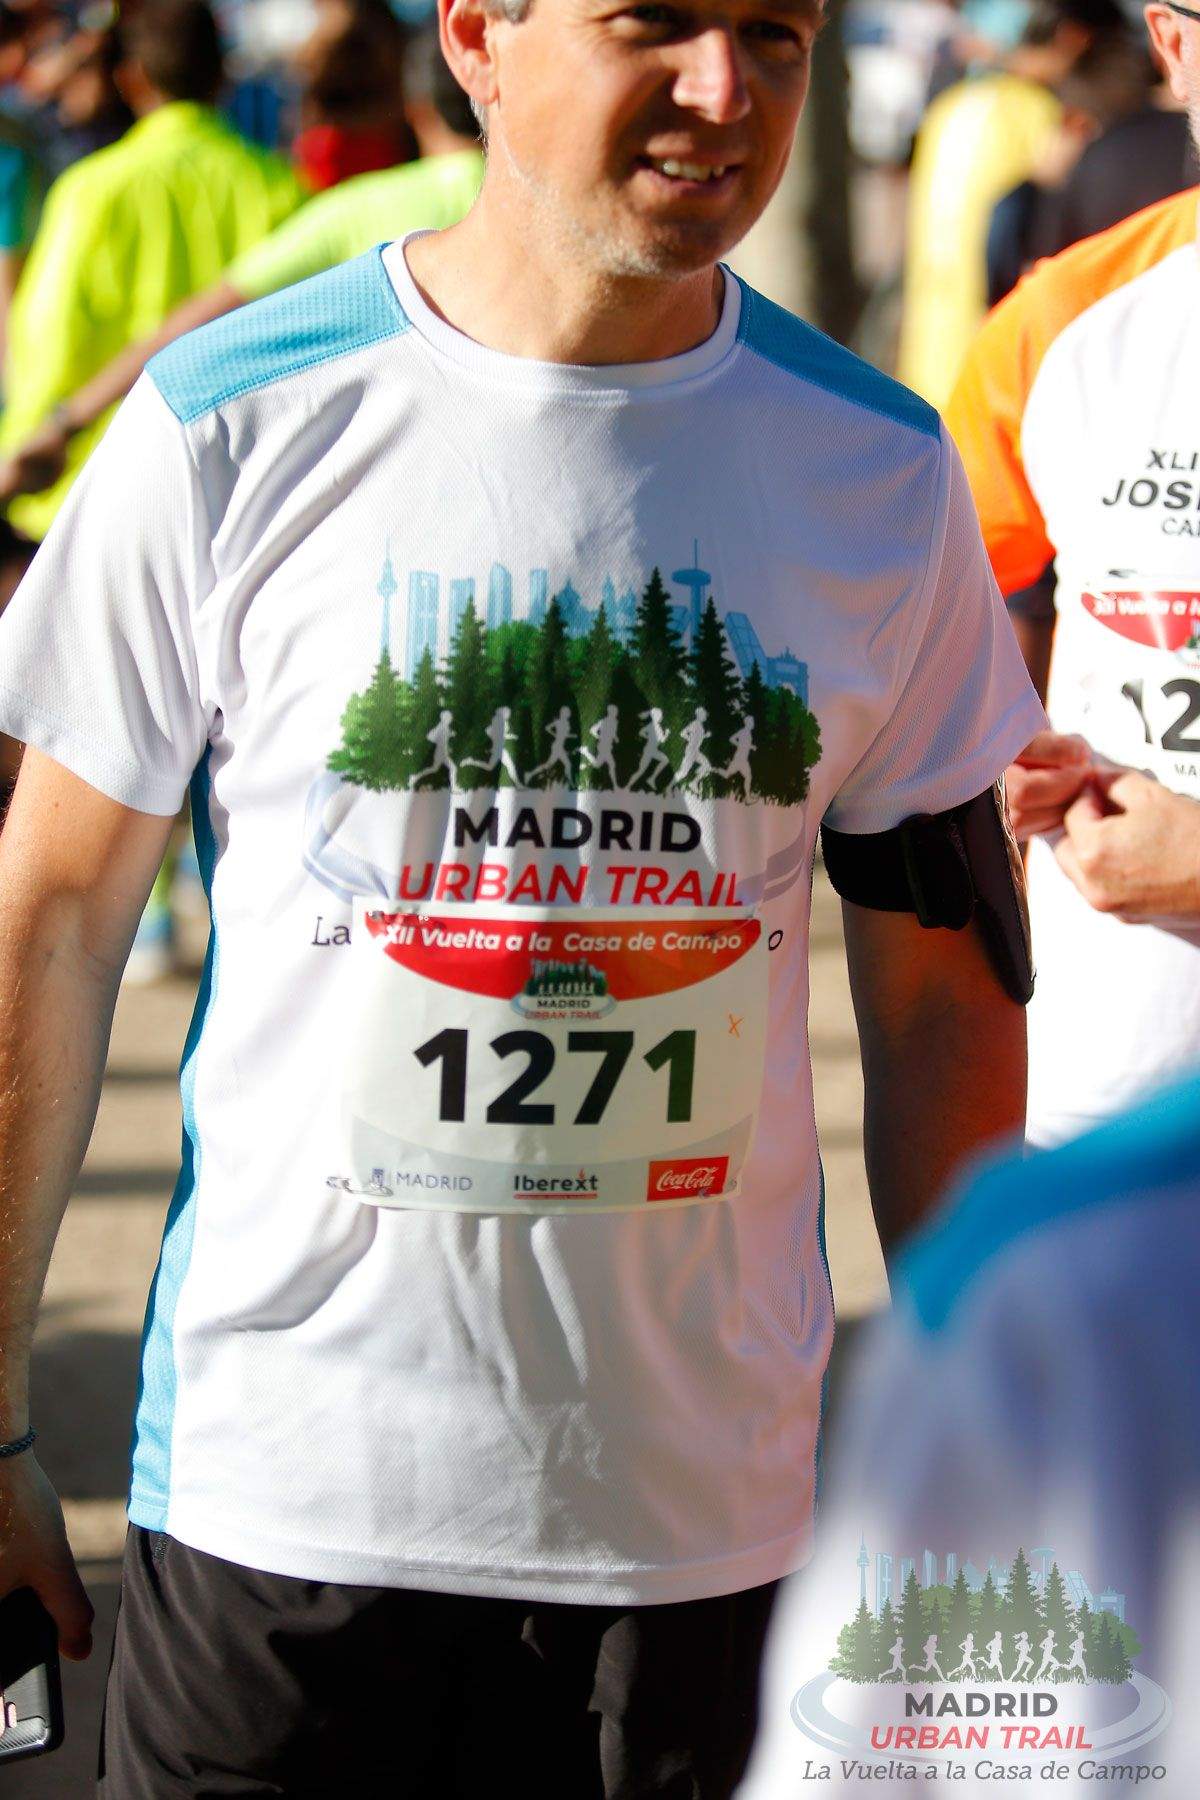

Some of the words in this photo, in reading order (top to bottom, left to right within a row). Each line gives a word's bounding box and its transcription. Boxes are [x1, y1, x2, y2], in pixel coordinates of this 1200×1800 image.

[1102, 479, 1200, 511] JOS
[1161, 516, 1200, 536] CA
[453, 807, 702, 853] MADRID
[400, 862, 589, 904] URBAN
[605, 866, 744, 908] TRAIL
[311, 916, 352, 947] La
[421, 927, 500, 950] Vuelta
[505, 933, 523, 951] a
[528, 931, 552, 952] la
[563, 932, 622, 952] Casa
[627, 931, 656, 951] de
[661, 932, 742, 954] Campo
[537, 1000, 591, 1009] MADRID
[413, 1028, 697, 1124] 1271
[396, 1172, 473, 1191] MADRID
[513, 1168, 598, 1193] Iberext
